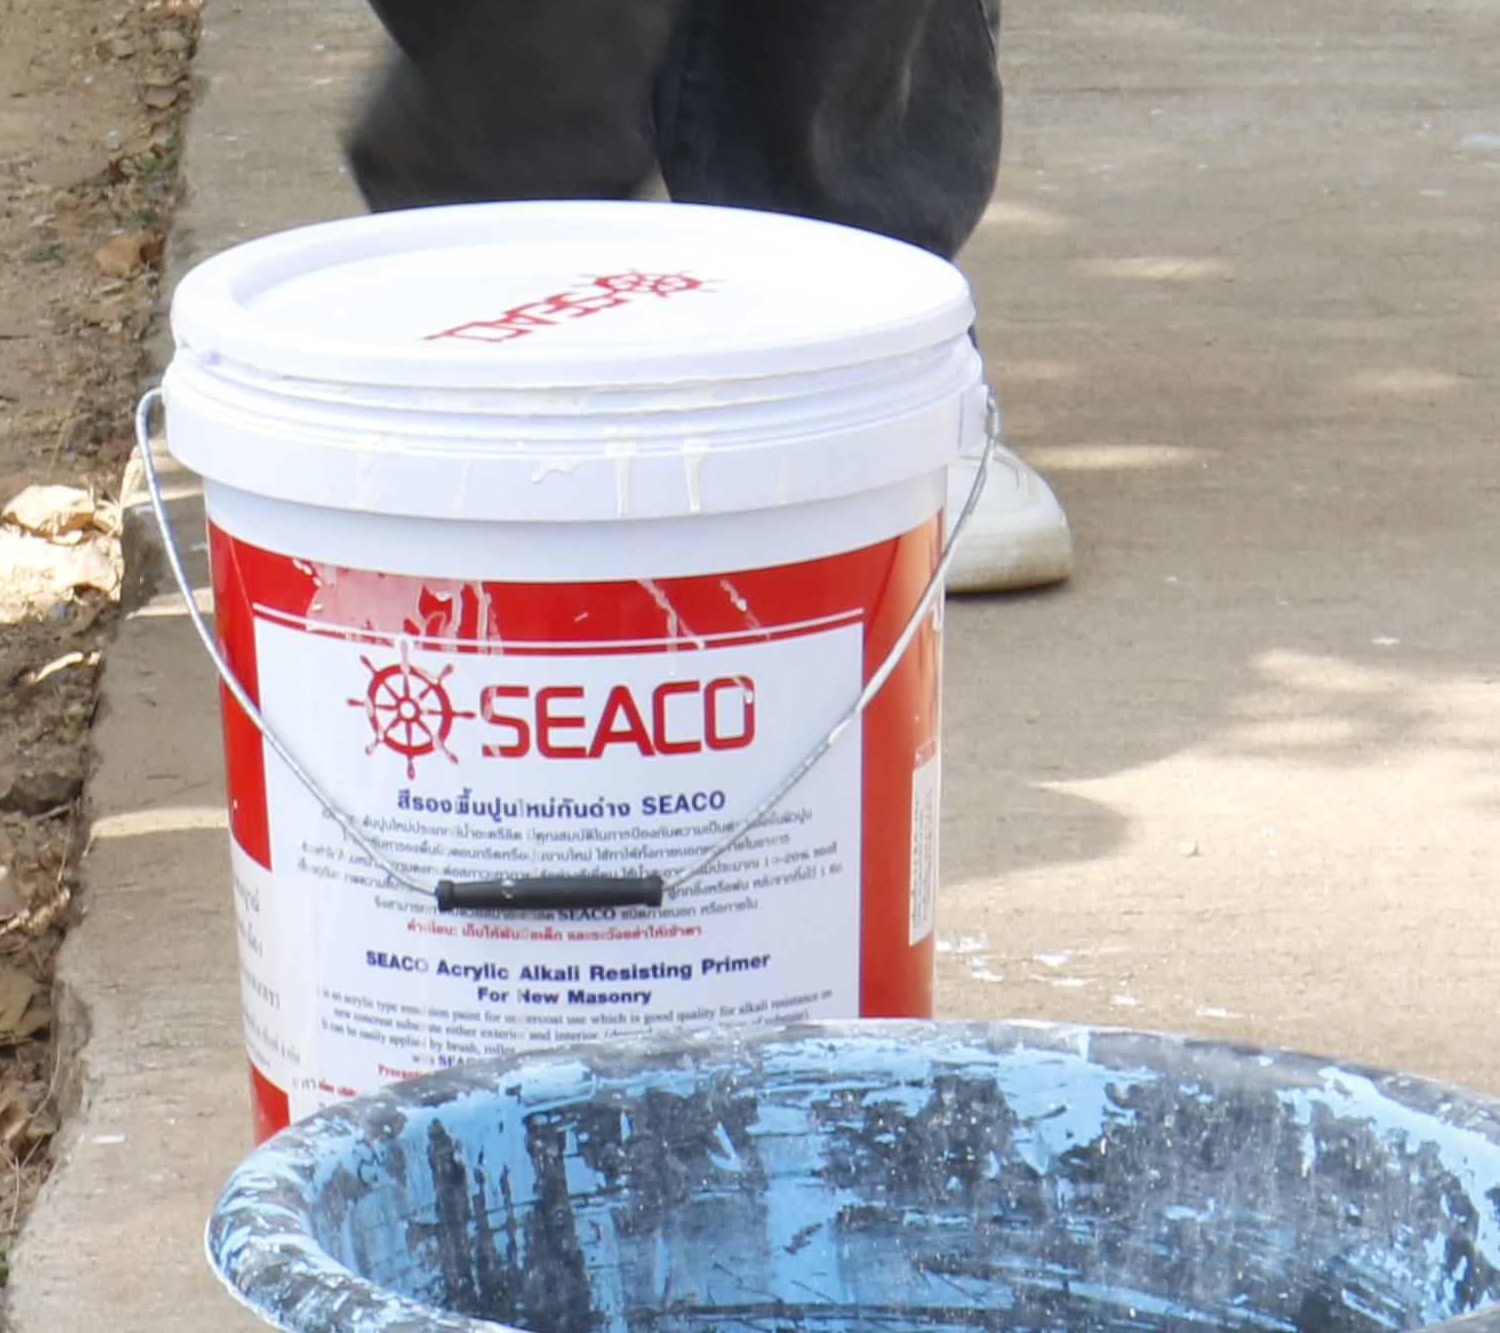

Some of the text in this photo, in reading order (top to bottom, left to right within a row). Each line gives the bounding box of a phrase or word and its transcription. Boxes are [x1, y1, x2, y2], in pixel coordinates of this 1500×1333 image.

[479, 674, 756, 760] SEACO
[641, 789, 726, 816] SEACO
[436, 959, 510, 981] Acrylic
[519, 964, 581, 982] Alkali
[590, 960, 693, 982] Resisting
[701, 953, 771, 976] Primer
[477, 986, 510, 1003] For
[567, 989, 653, 1008] Masonry
[452, 1005, 481, 1024] paint
[484, 1008, 501, 1023] for
[567, 1012, 588, 1025] use
[591, 1010, 627, 1025] which
[630, 1010, 641, 1025] is
[643, 1008, 674, 1028] good
[676, 1005, 716, 1024] quality
[720, 1003, 735, 1018] for
[738, 998, 769, 1015] alkali
[429, 1037, 444, 1054] by
[529, 1027, 552, 1041] and
[555, 1028, 599, 1041] interior
